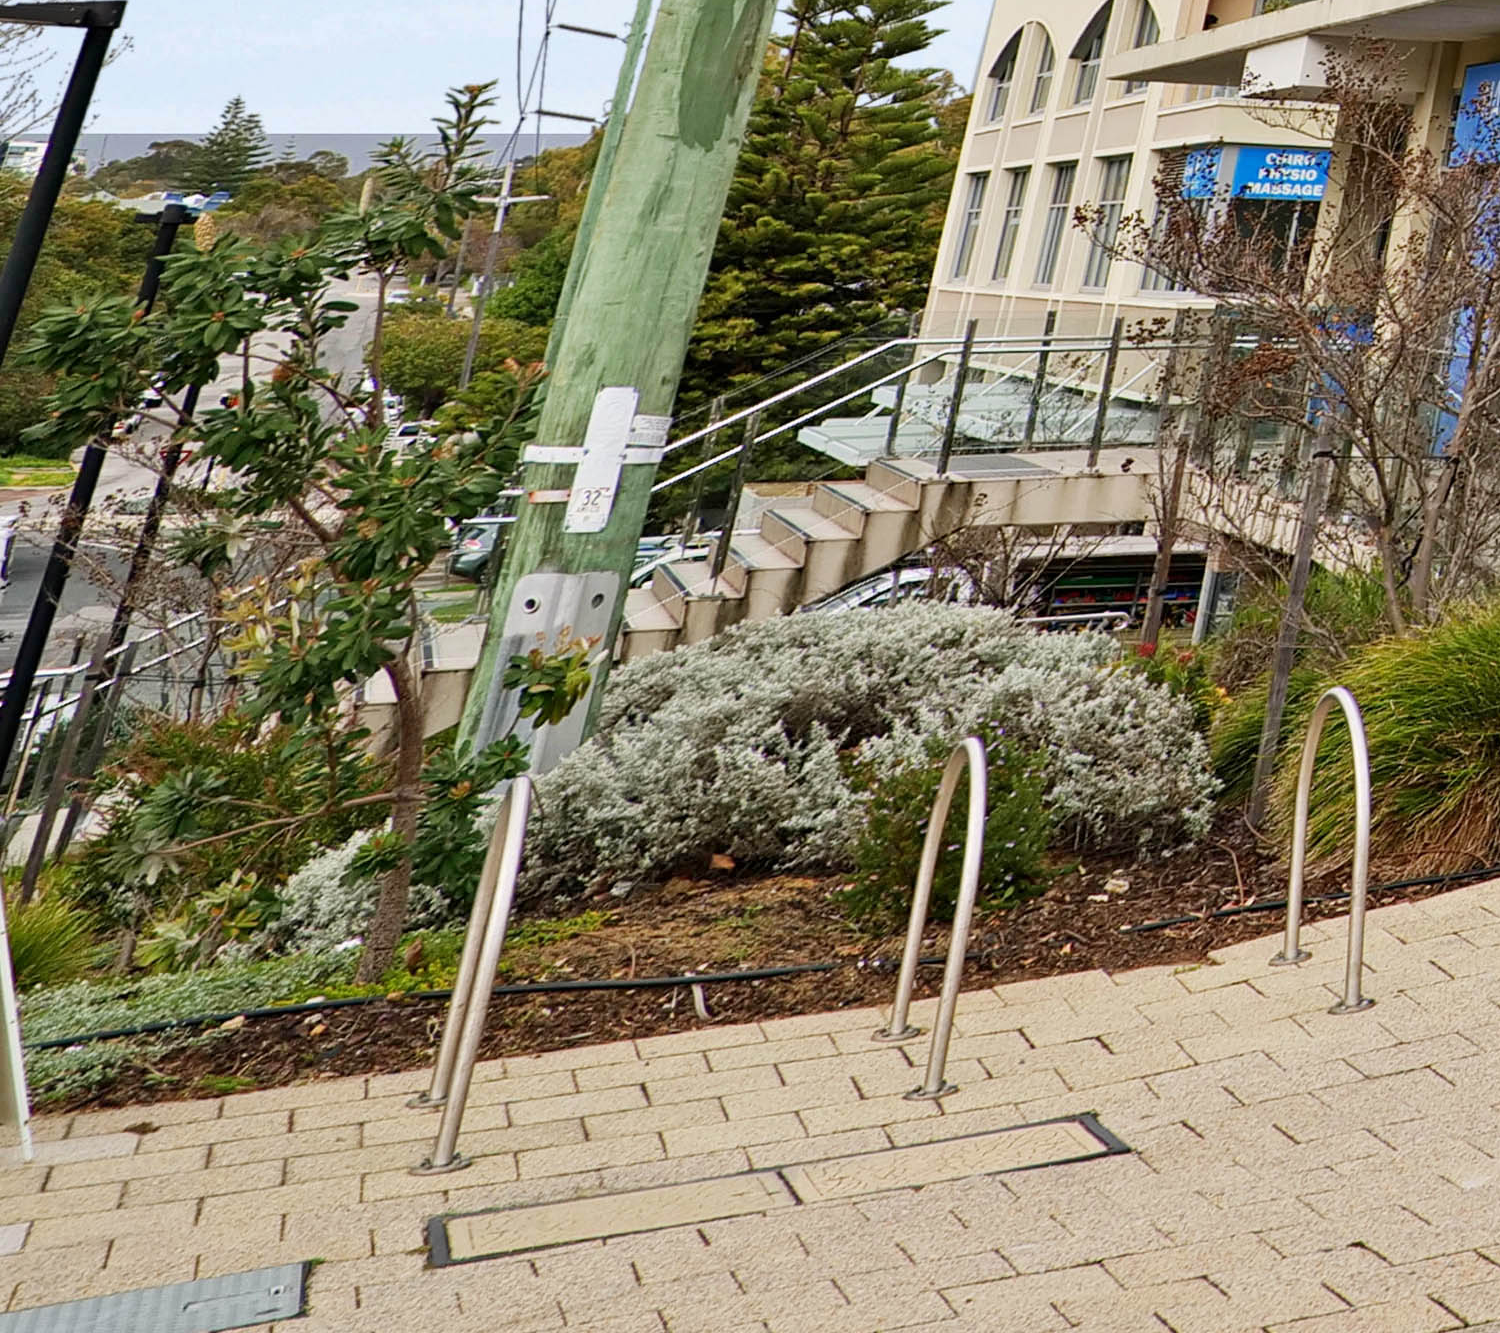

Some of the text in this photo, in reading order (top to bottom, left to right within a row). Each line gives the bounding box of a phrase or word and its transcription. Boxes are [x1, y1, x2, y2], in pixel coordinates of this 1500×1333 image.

[1258, 168, 1318, 181] PHYSIO
[1247, 182, 1324, 196] MASSAGE
[583, 489, 602, 507] 32
